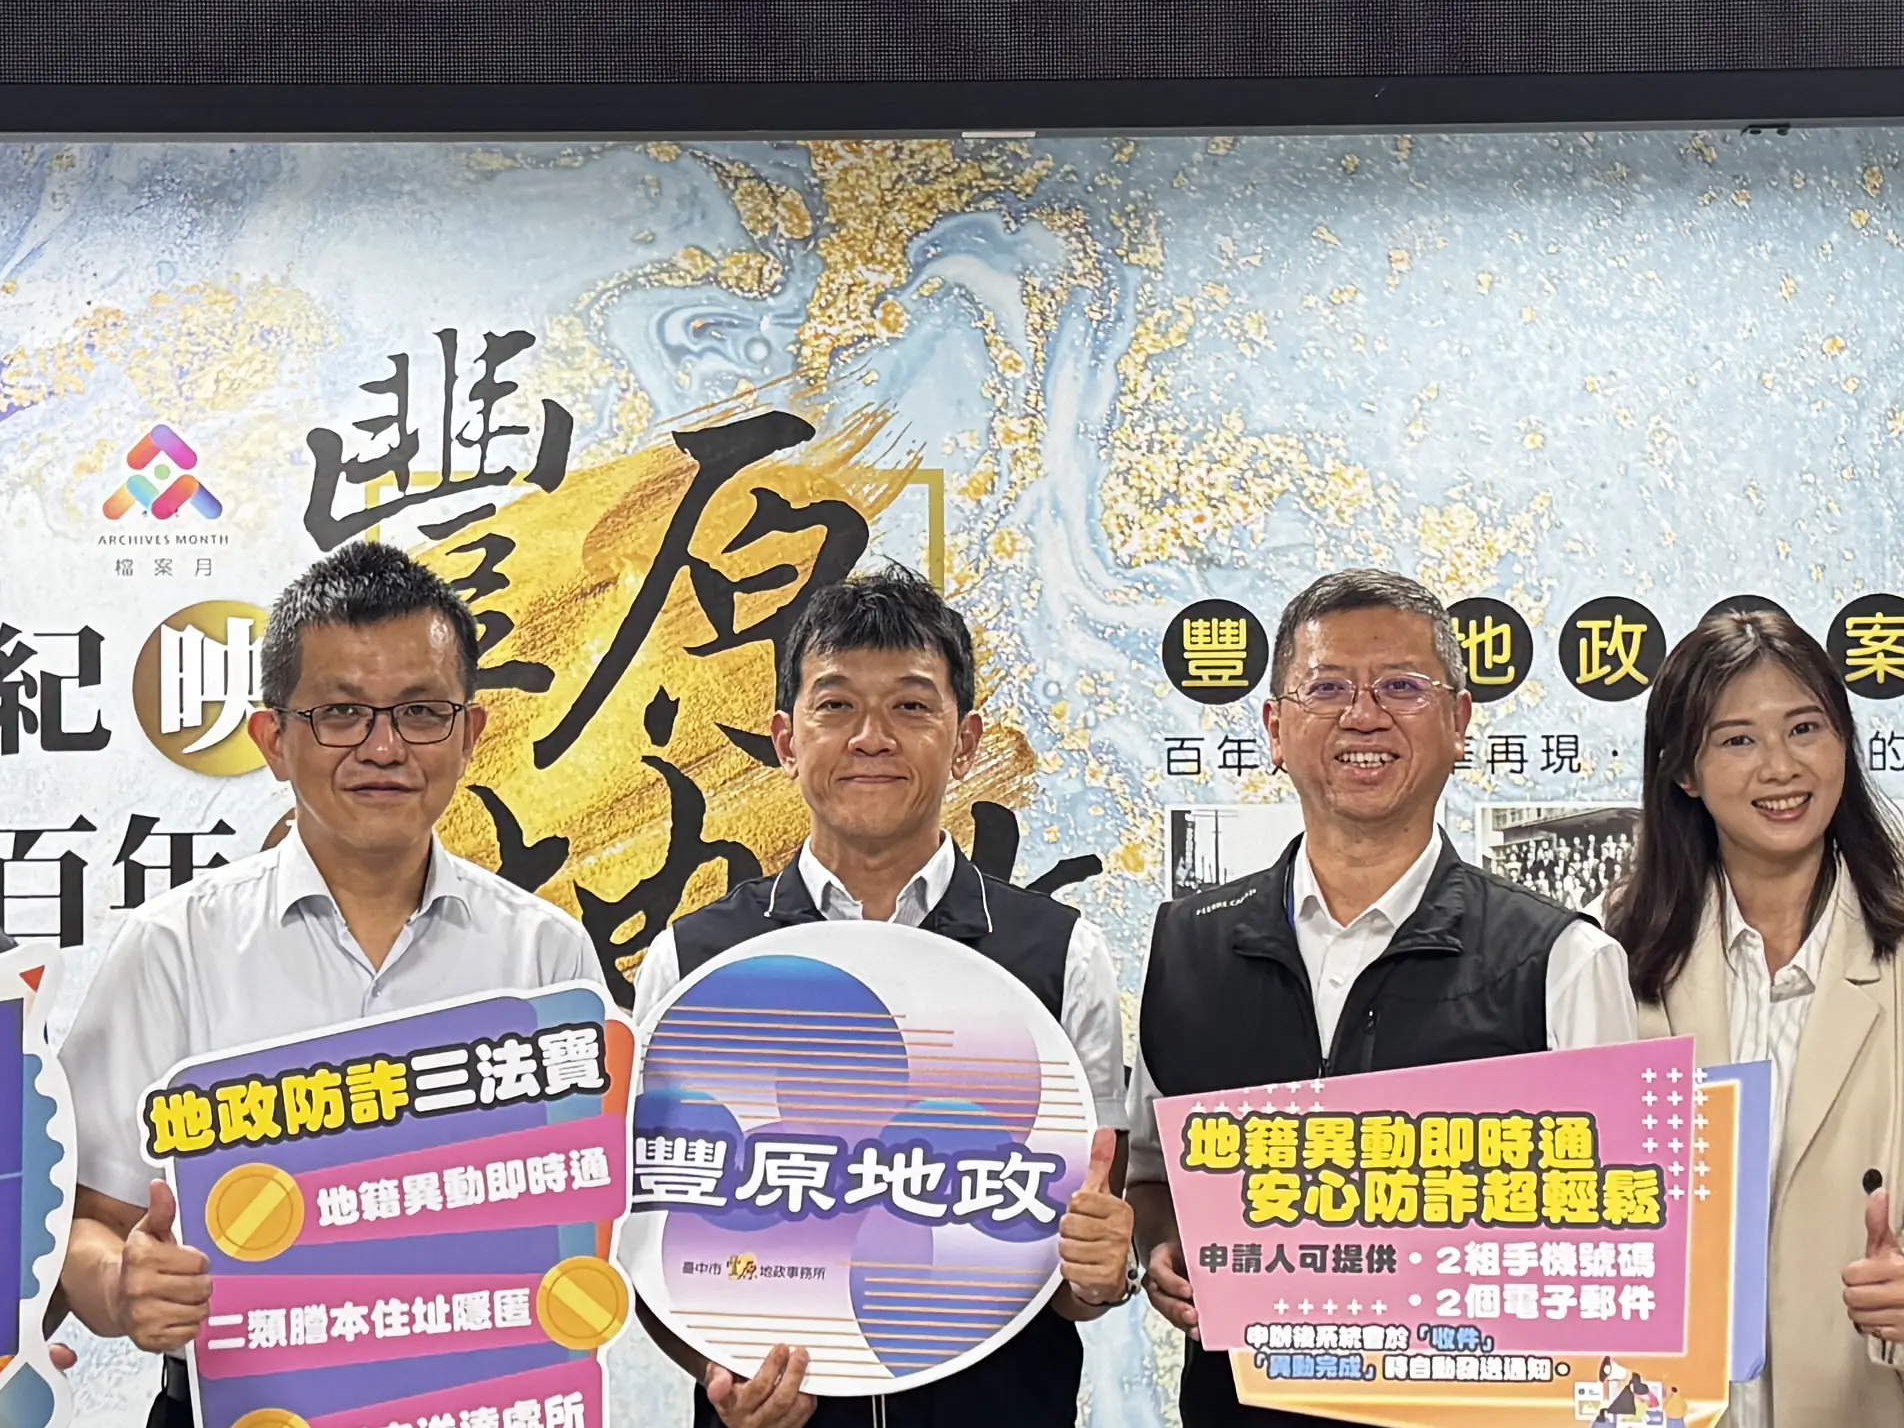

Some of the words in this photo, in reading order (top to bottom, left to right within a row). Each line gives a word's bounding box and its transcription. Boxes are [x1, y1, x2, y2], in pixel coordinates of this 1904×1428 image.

[98, 535, 170, 545] ARCHIVES
[176, 535, 228, 545] MONTH
[115, 558, 213, 577] 檔案月
[150, 1028, 603, 1155] 地政防詐三法寶
[1185, 1115, 1596, 1171] 地籍異動即時通
[316, 1147, 612, 1227] 地籍異動即時通
[634, 1134, 1058, 1224] 豐原地政
[1247, 1169, 1662, 1226] 安心防詐超輕鬆
[1199, 1244, 1397, 1274] 申請人可提供
[1436, 1242, 1656, 1279] 2組手機號碼
[207, 1287, 533, 1351] 二類謄本住址隱匿
[1436, 1283, 1656, 1321] 2個電子郵件
